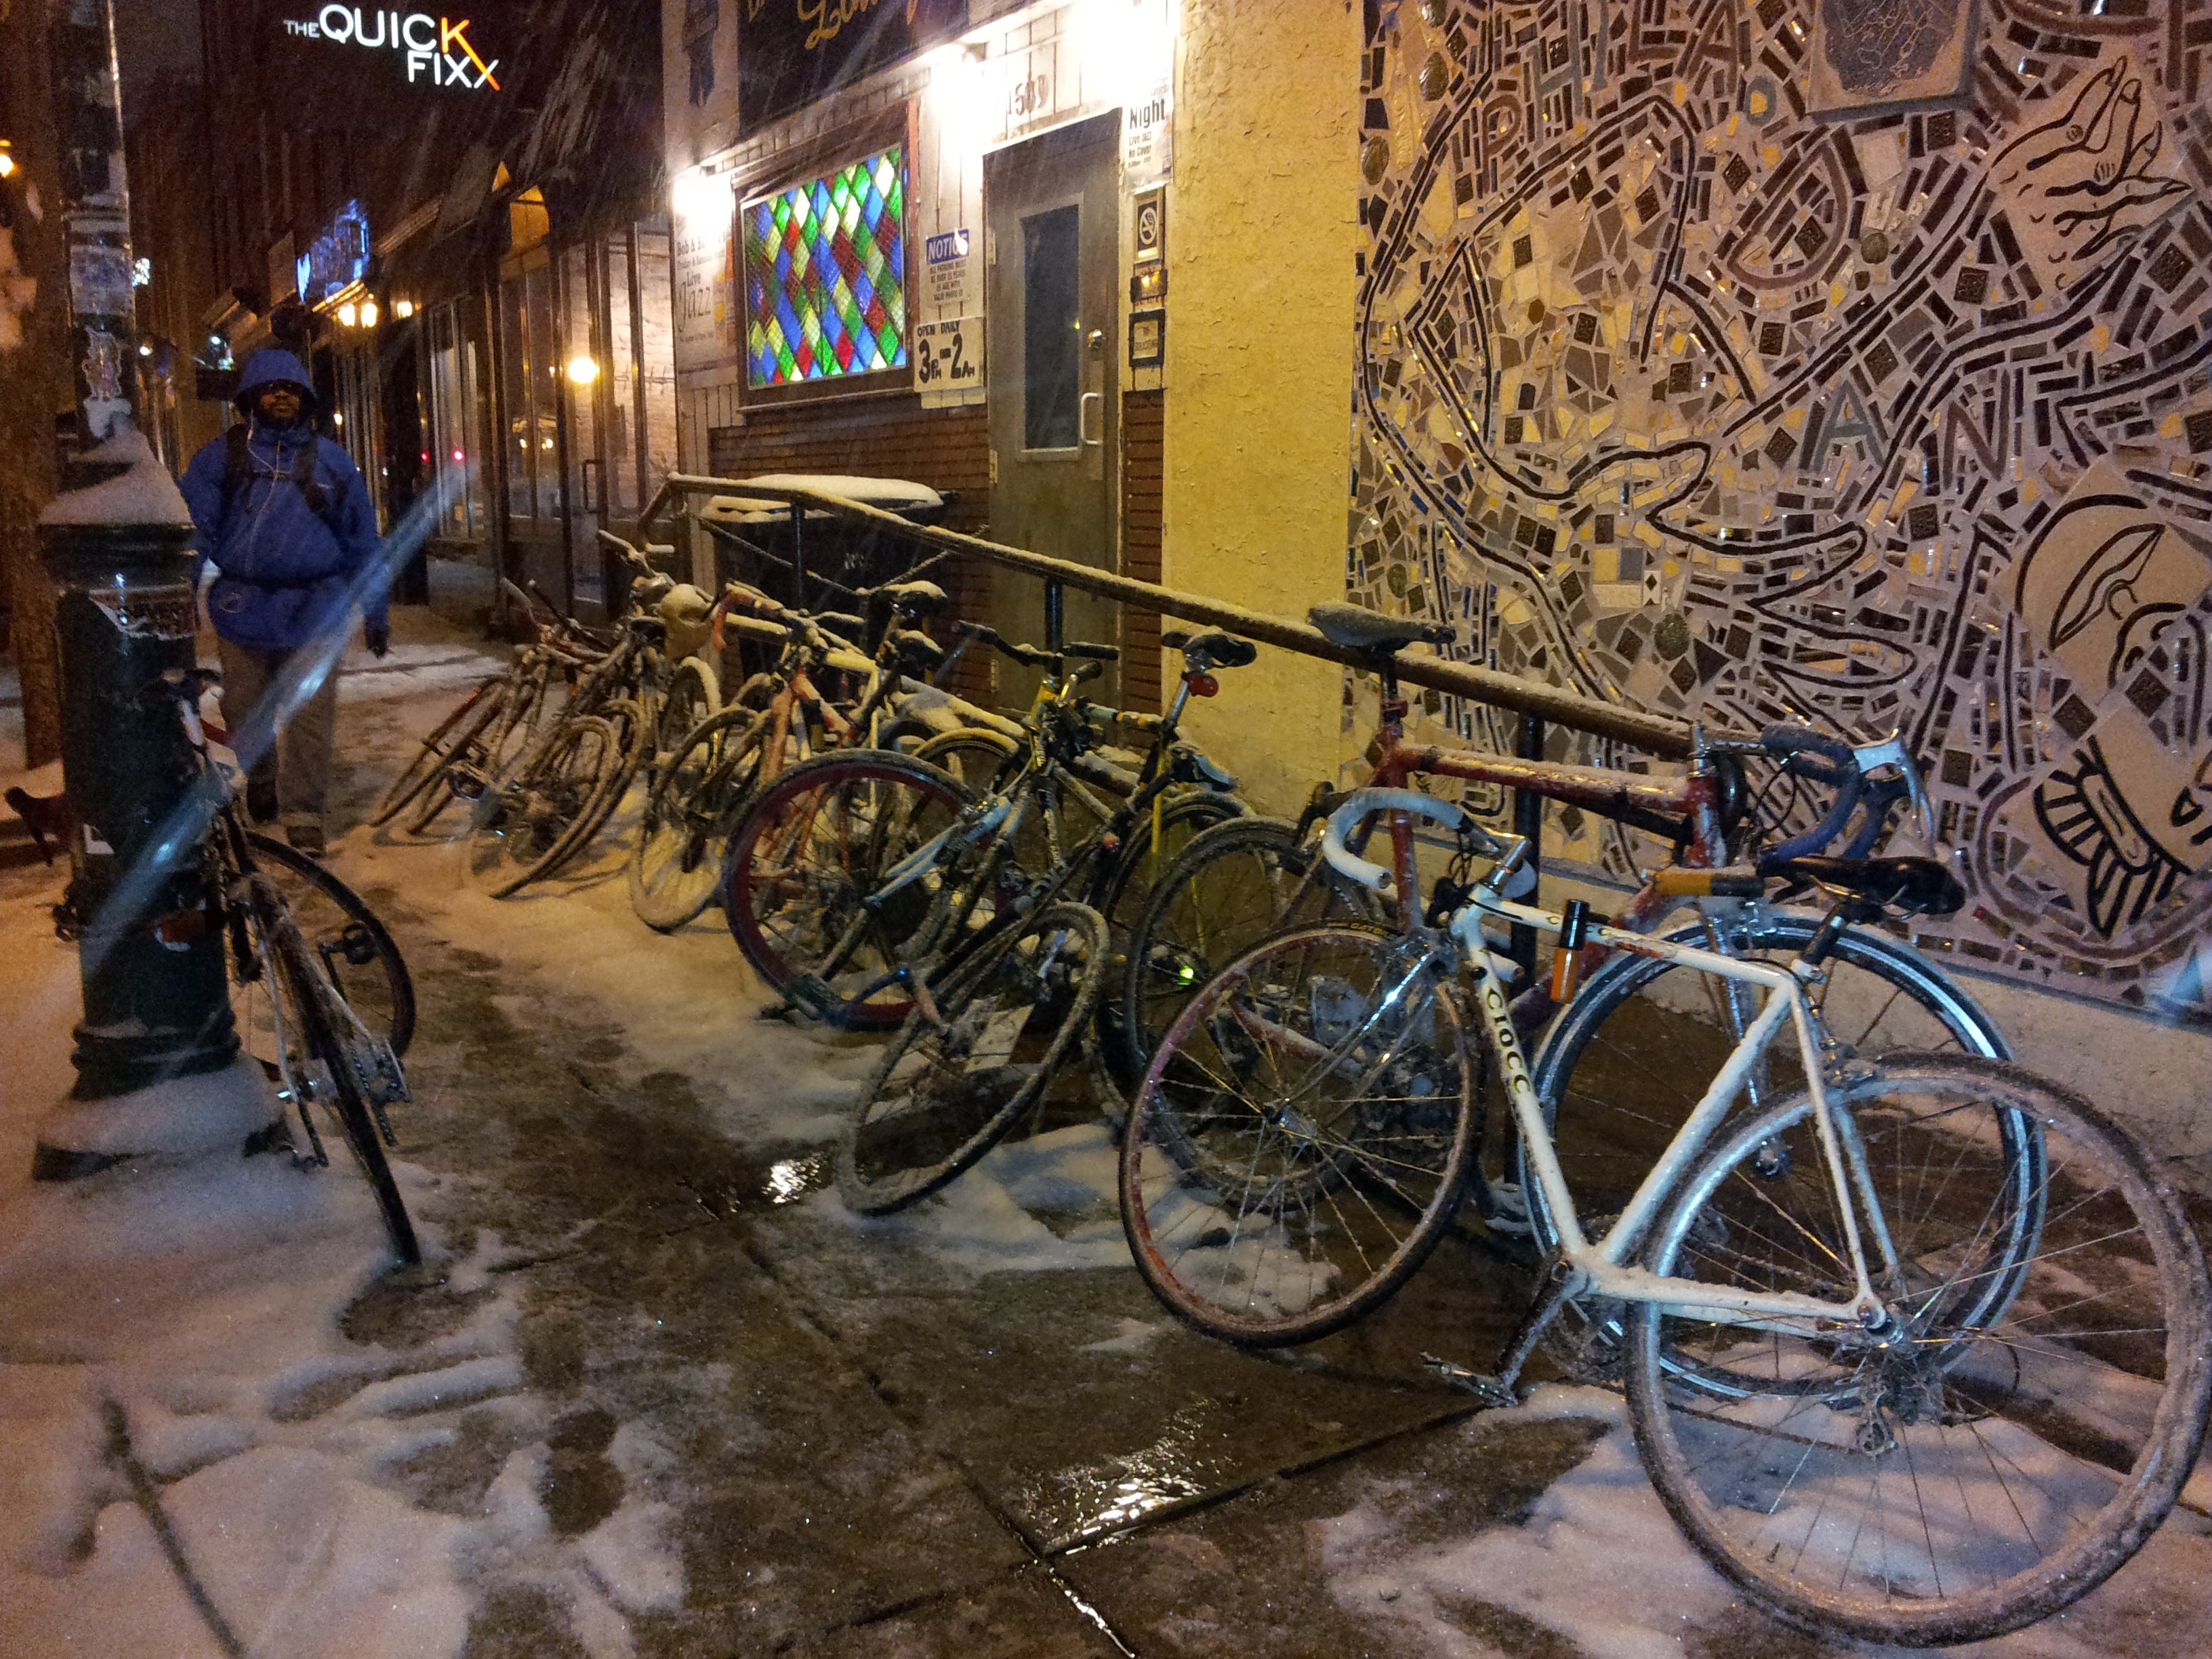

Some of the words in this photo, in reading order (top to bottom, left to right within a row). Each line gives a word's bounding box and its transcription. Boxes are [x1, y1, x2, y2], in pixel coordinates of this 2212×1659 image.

[283, 20, 320, 38] THE
[1129, 98, 1165, 129] Night
[677, 241, 689, 256] Bob
[687, 272, 701, 287] Live
[678, 281, 711, 332] Jazz
[917, 324, 935, 337] OPEN
[941, 320, 960, 333] DAILY
[1486, 987, 1532, 1094] CIOCC
